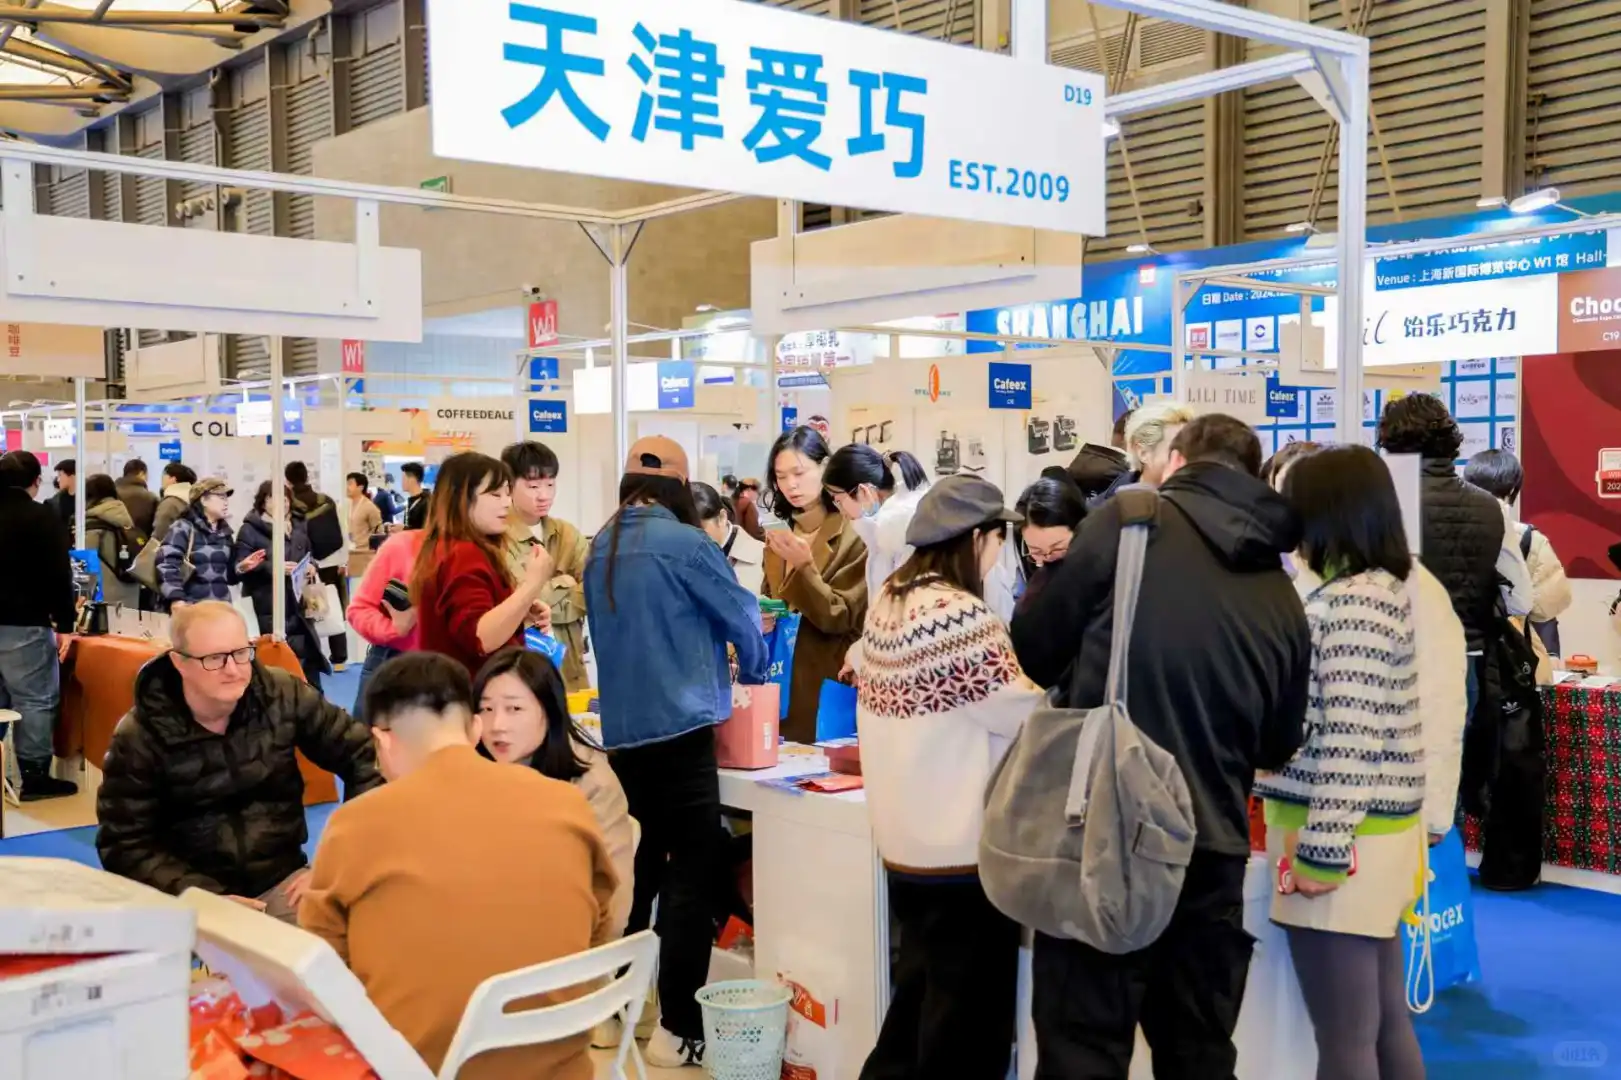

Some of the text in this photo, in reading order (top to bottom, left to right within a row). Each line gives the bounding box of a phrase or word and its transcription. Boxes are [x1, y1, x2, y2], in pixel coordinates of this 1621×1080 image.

[500, 2, 928, 178] 天津爱巧
[1064, 84, 1092, 105] D19
[949, 159, 1069, 203] EST.2009
[1377, 273, 1411, 286] Venue
[1223, 293, 1244, 303] Date
[997, 296, 1144, 346] SHANGHAI
[1403, 307, 1516, 338] 饴乐巧克力
[994, 378, 1027, 391] Cafeex
